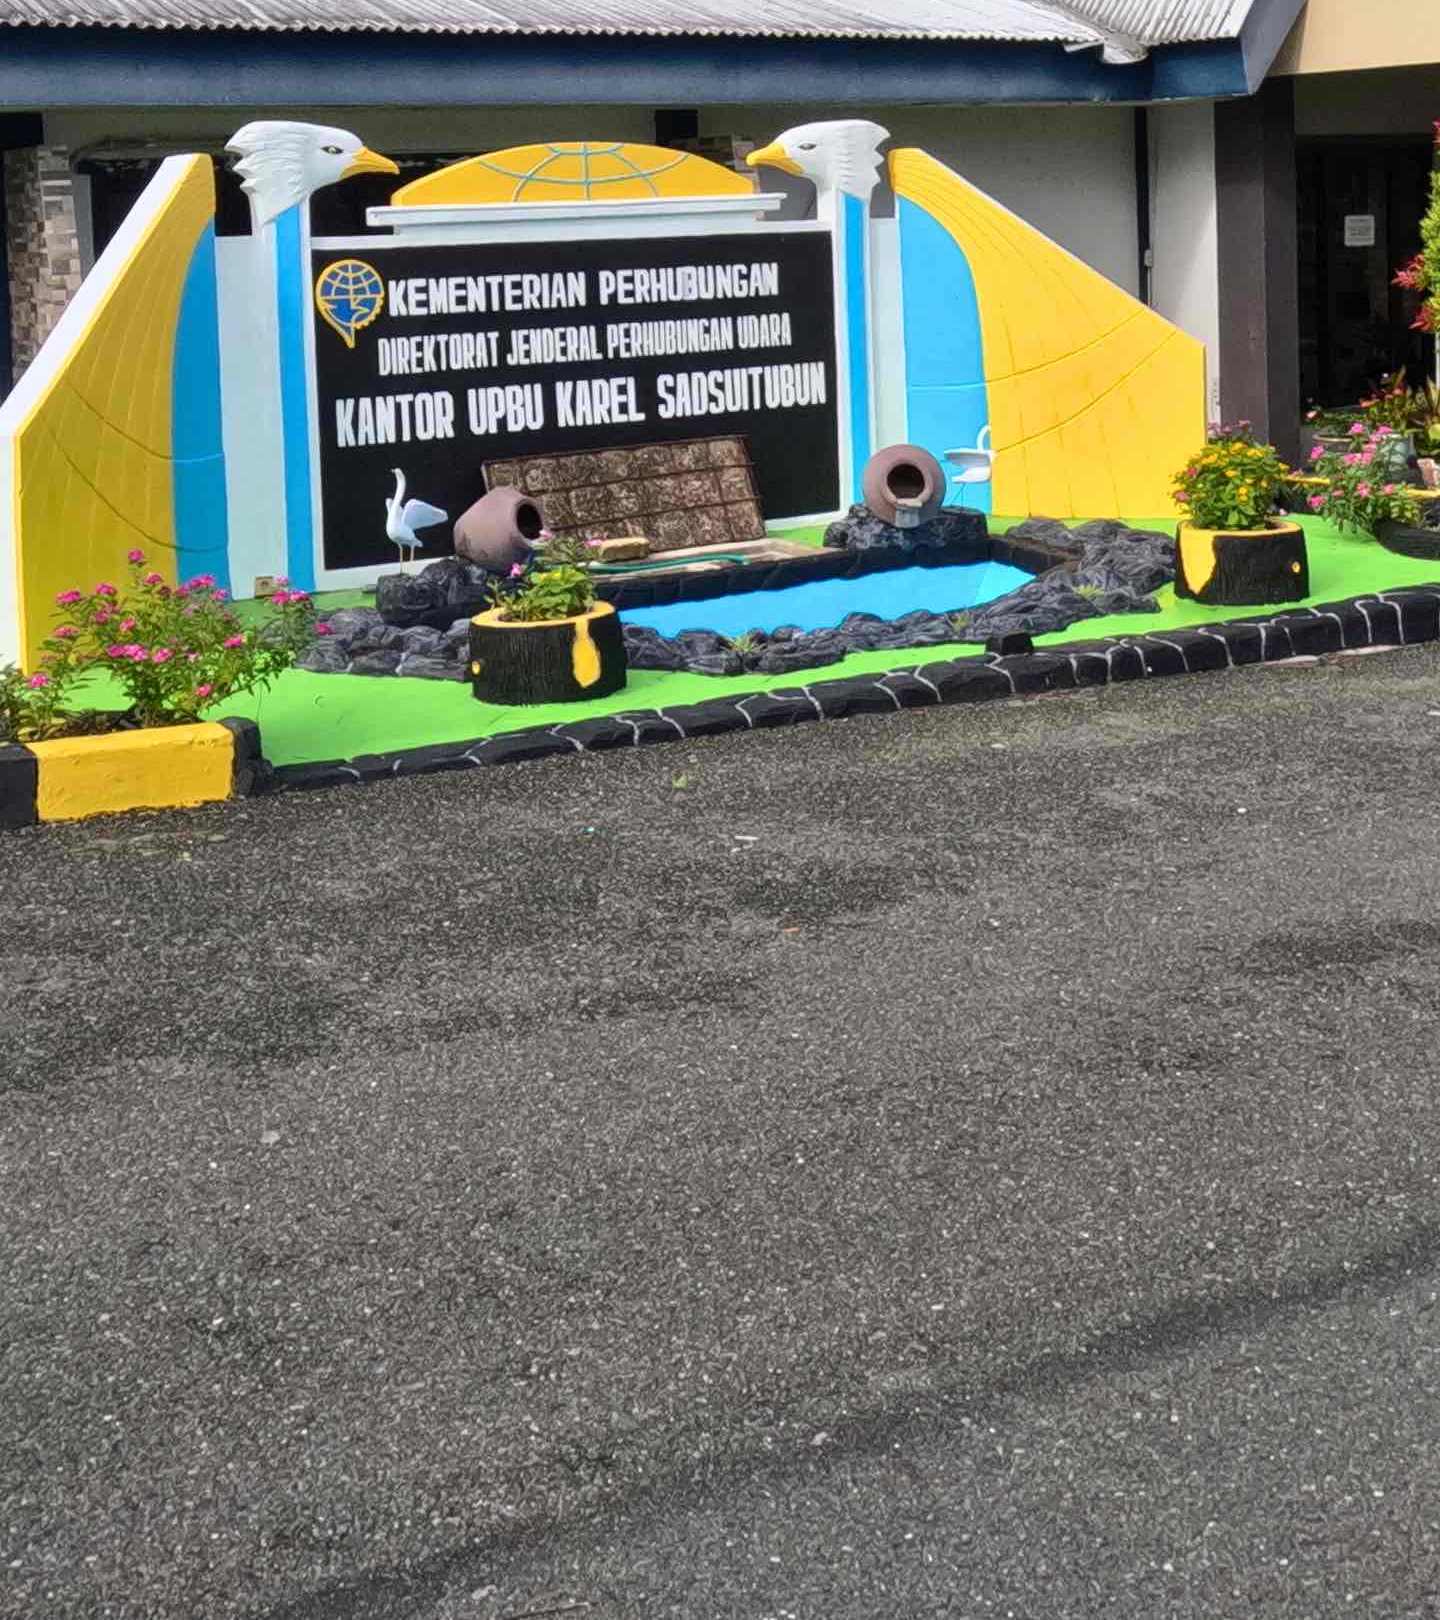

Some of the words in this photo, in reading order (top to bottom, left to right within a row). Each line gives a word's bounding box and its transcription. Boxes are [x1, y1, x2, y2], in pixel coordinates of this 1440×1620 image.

[389, 272, 586, 316] KEMENTERIAN
[599, 263, 778, 305] PERHUBUNGAN
[378, 332, 498, 375] DIREKTORAT
[507, 326, 602, 365] JENDERAL
[607, 317, 733, 358] PERHUBUNGAN
[737, 313, 791, 348] UDARA
[336, 391, 454, 447] KANTOR
[468, 383, 544, 435] UPBU
[556, 377, 645, 427] KAREL
[657, 362, 826, 418] SADSUITUBUN
